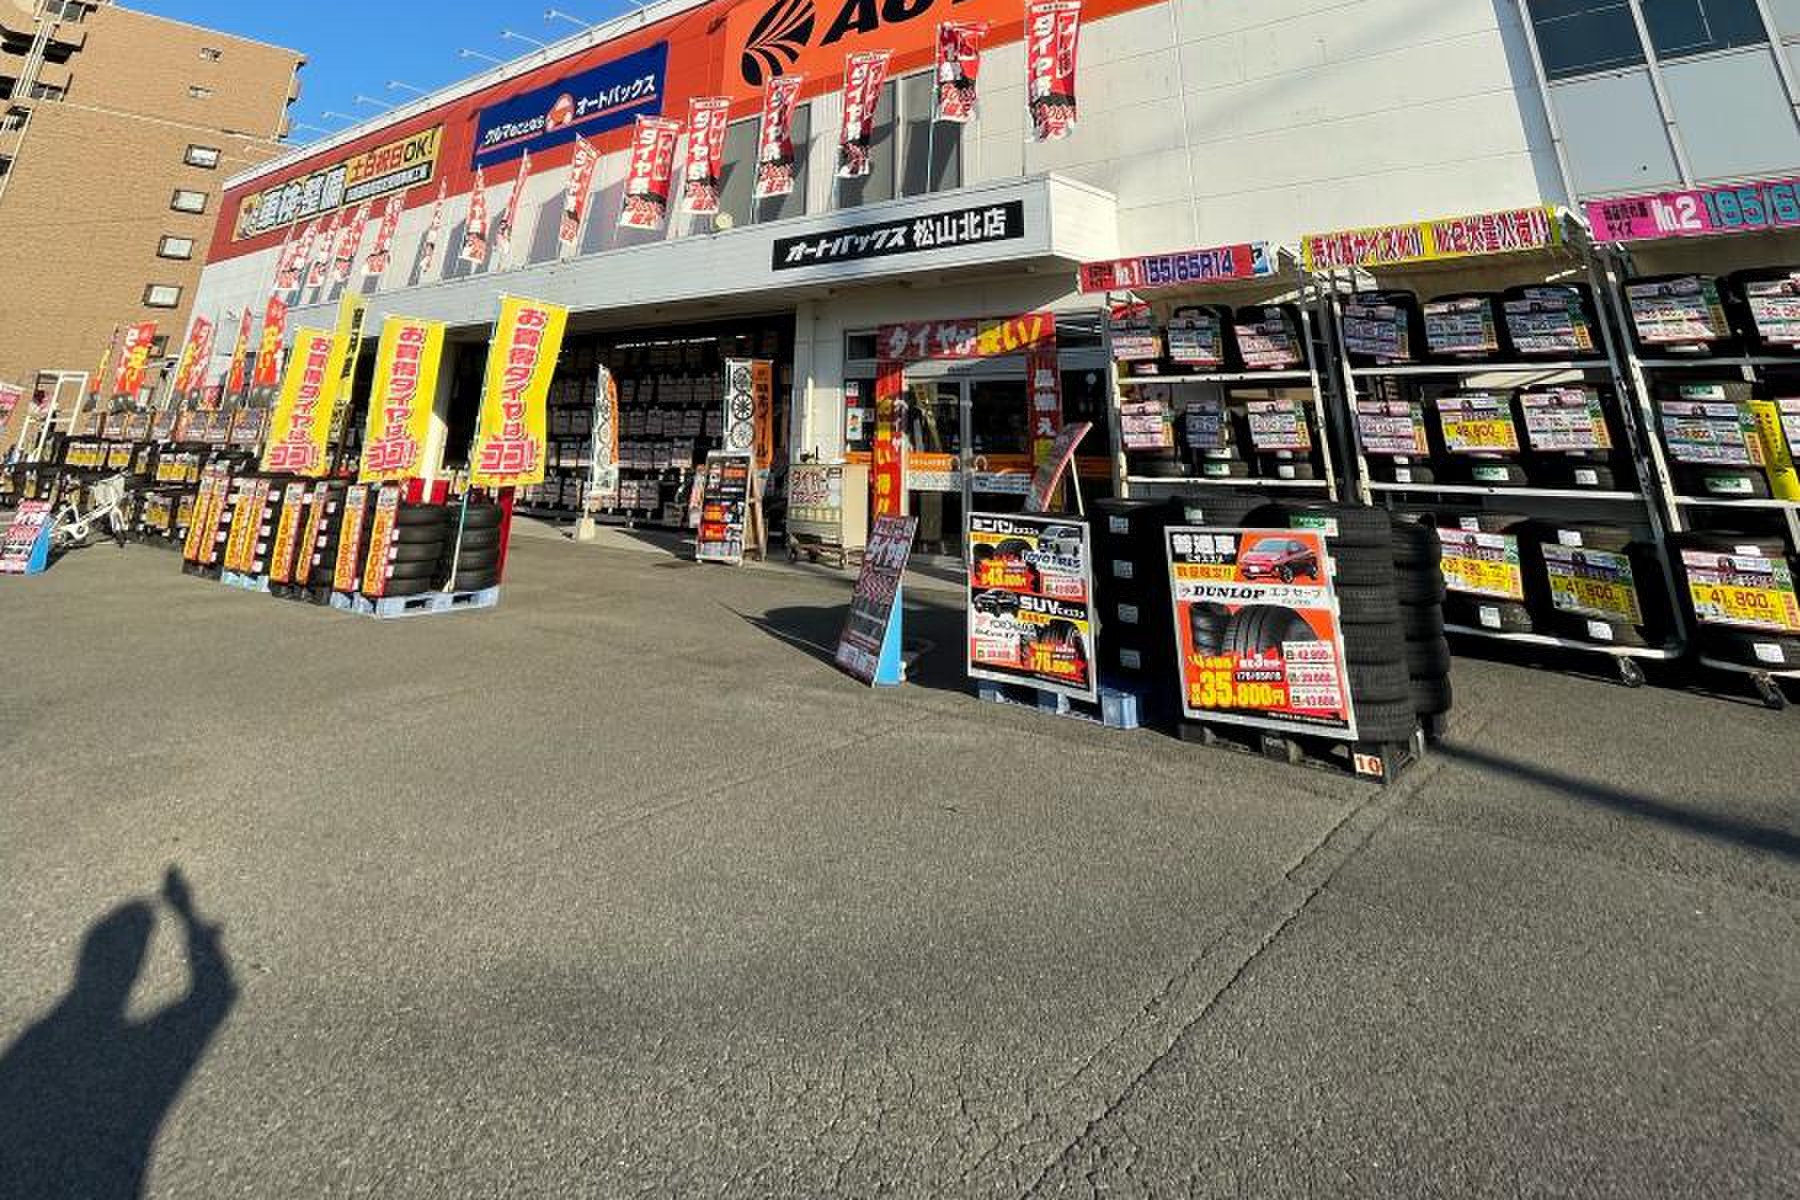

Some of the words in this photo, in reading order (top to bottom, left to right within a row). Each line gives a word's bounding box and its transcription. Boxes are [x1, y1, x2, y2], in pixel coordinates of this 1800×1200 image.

[576, 74, 656, 116] オートバックス
[1703, 182, 1800, 228] 195/6
[784, 224, 906, 263] オートバックス
[912, 208, 1007, 248] 松山北店
[1020, 596, 1059, 615] SUV
[1193, 585, 1265, 600] DUNLOP
